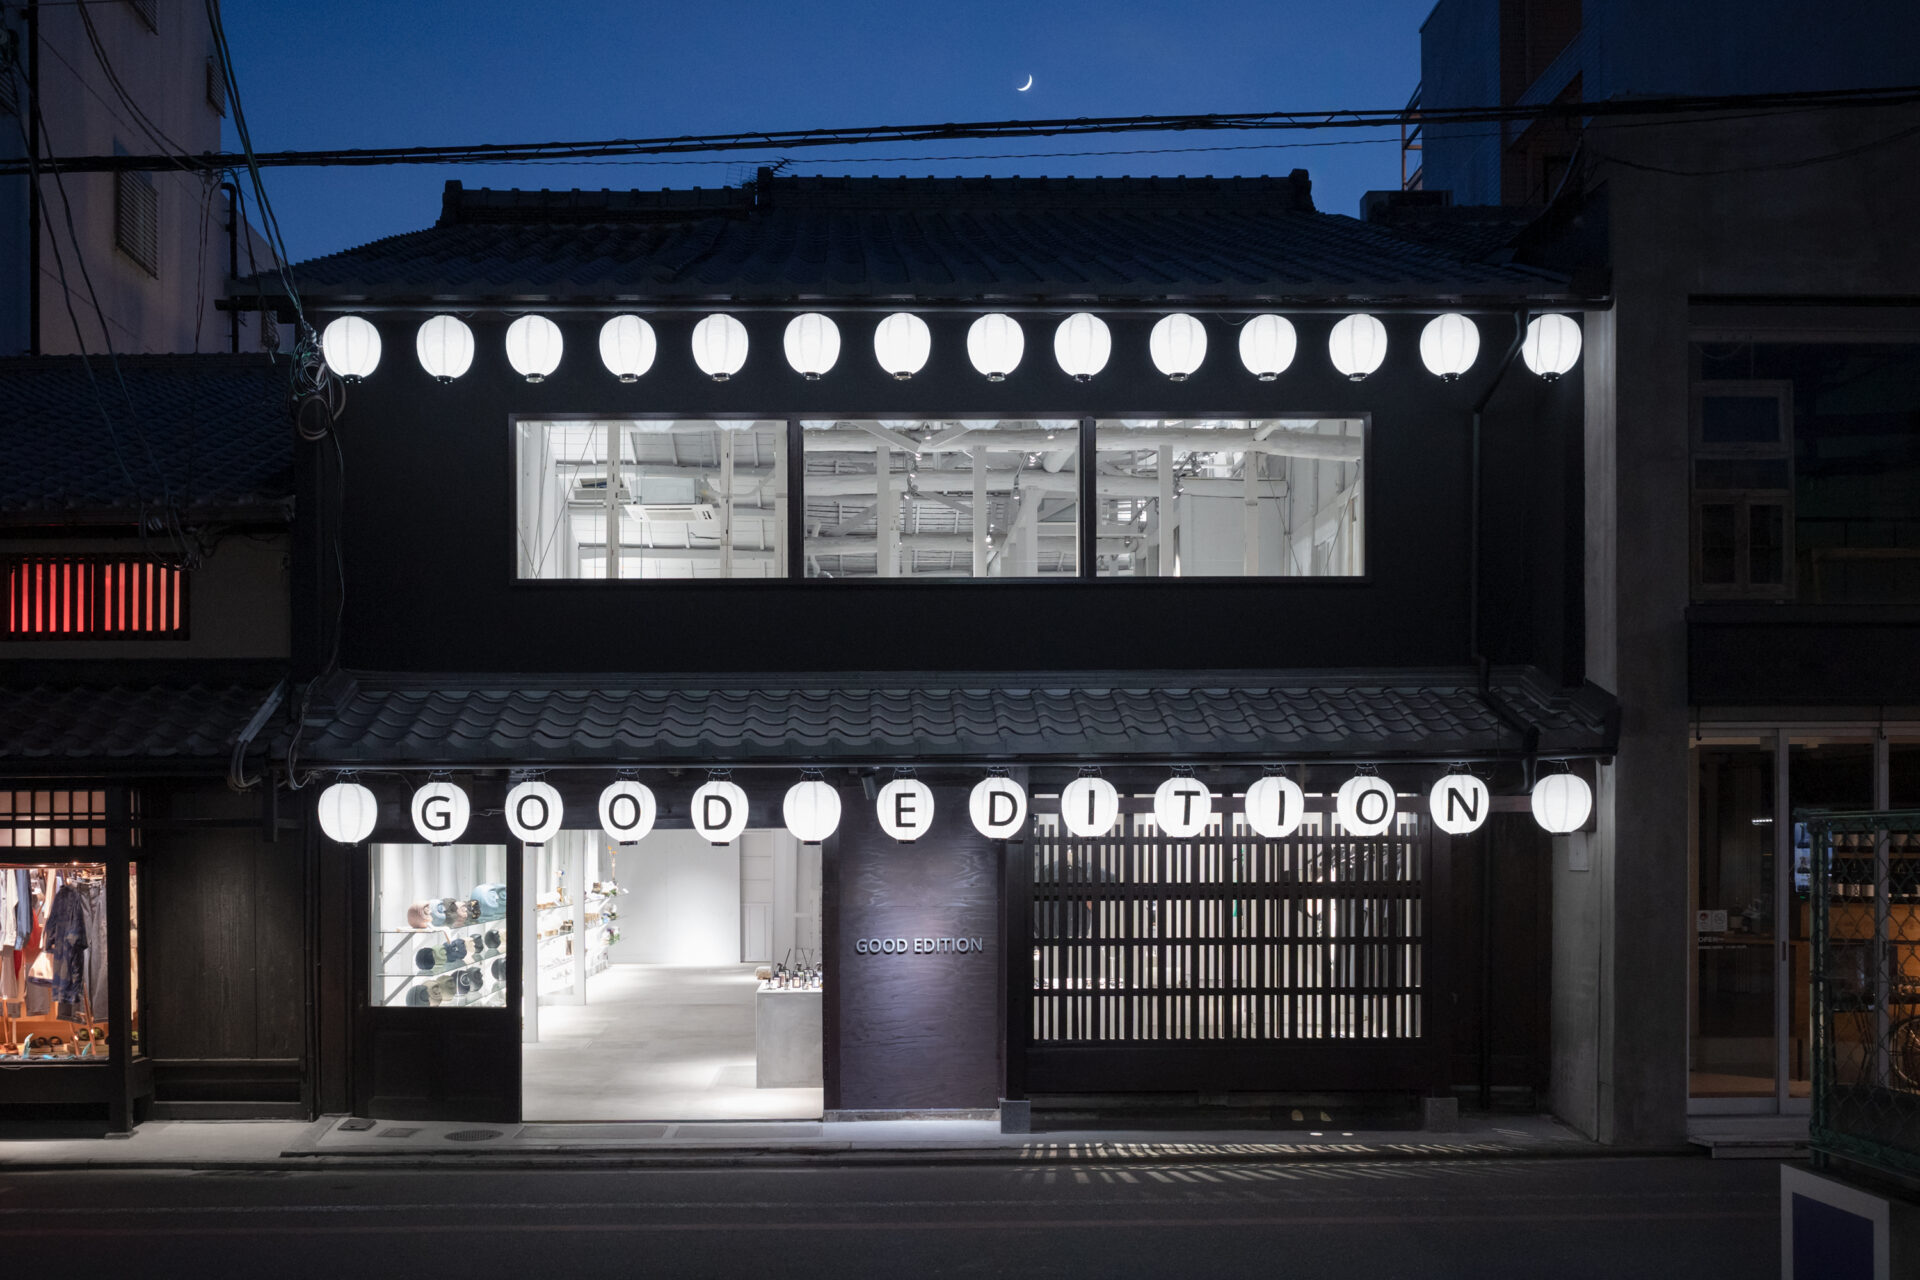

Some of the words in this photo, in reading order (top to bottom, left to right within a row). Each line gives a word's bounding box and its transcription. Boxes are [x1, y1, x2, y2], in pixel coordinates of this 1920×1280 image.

[422, 793, 732, 831] GOOD
[895, 787, 1479, 829] EDITION
[856, 938, 908, 953] GOOD
[914, 937, 983, 953] EDITION
